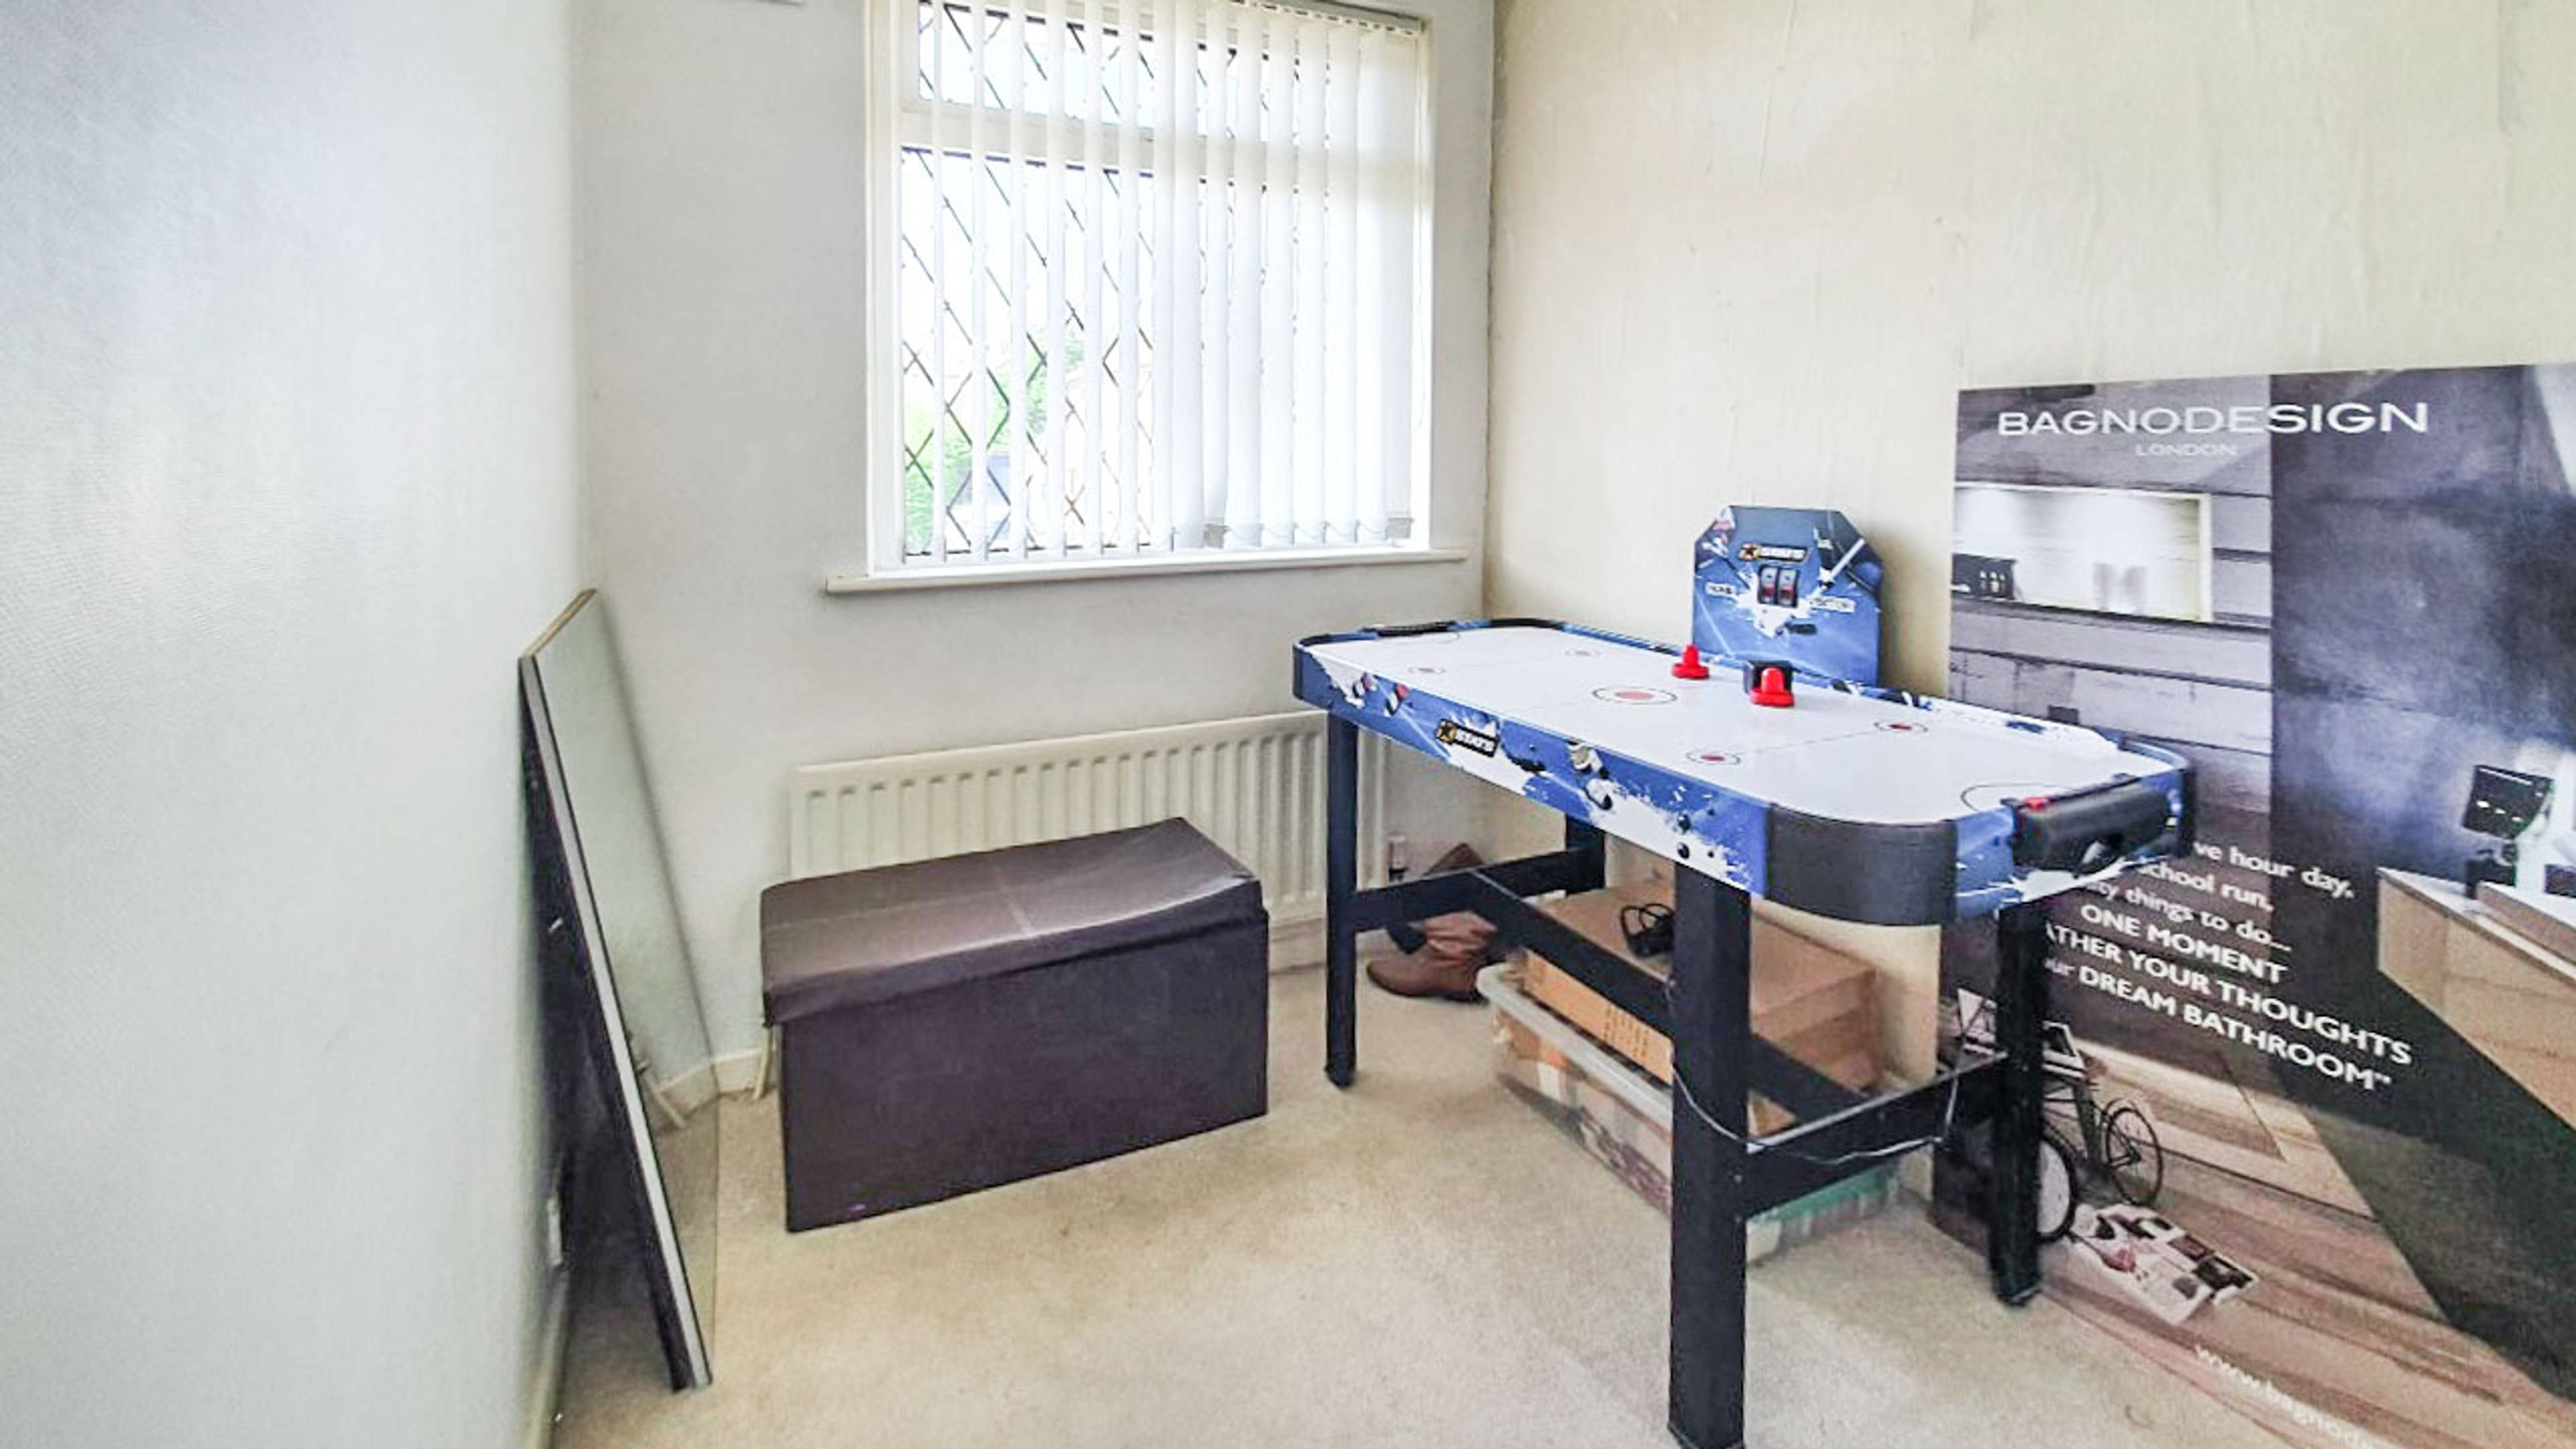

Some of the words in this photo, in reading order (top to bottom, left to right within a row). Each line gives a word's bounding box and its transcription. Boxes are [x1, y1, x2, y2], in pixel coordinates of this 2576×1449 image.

[1997, 402, 2429, 436] BAGNODESIGN
[2135, 443, 2239, 457] LONDON
[2193, 841, 2222, 861] ve
[2229, 845, 2296, 877] hour
[2301, 866, 2355, 899] day.
[2124, 886, 2195, 923] things
[2200, 910, 2229, 931] to
[2080, 904, 2143, 938] ONE
[2147, 923, 2289, 984] MOMENT
[2045, 920, 2123, 965] THER
[2129, 949, 2211, 996] YOUR
[2216, 978, 2412, 1065] THOUGHTS
[2080, 965, 2176, 1018] DREAM
